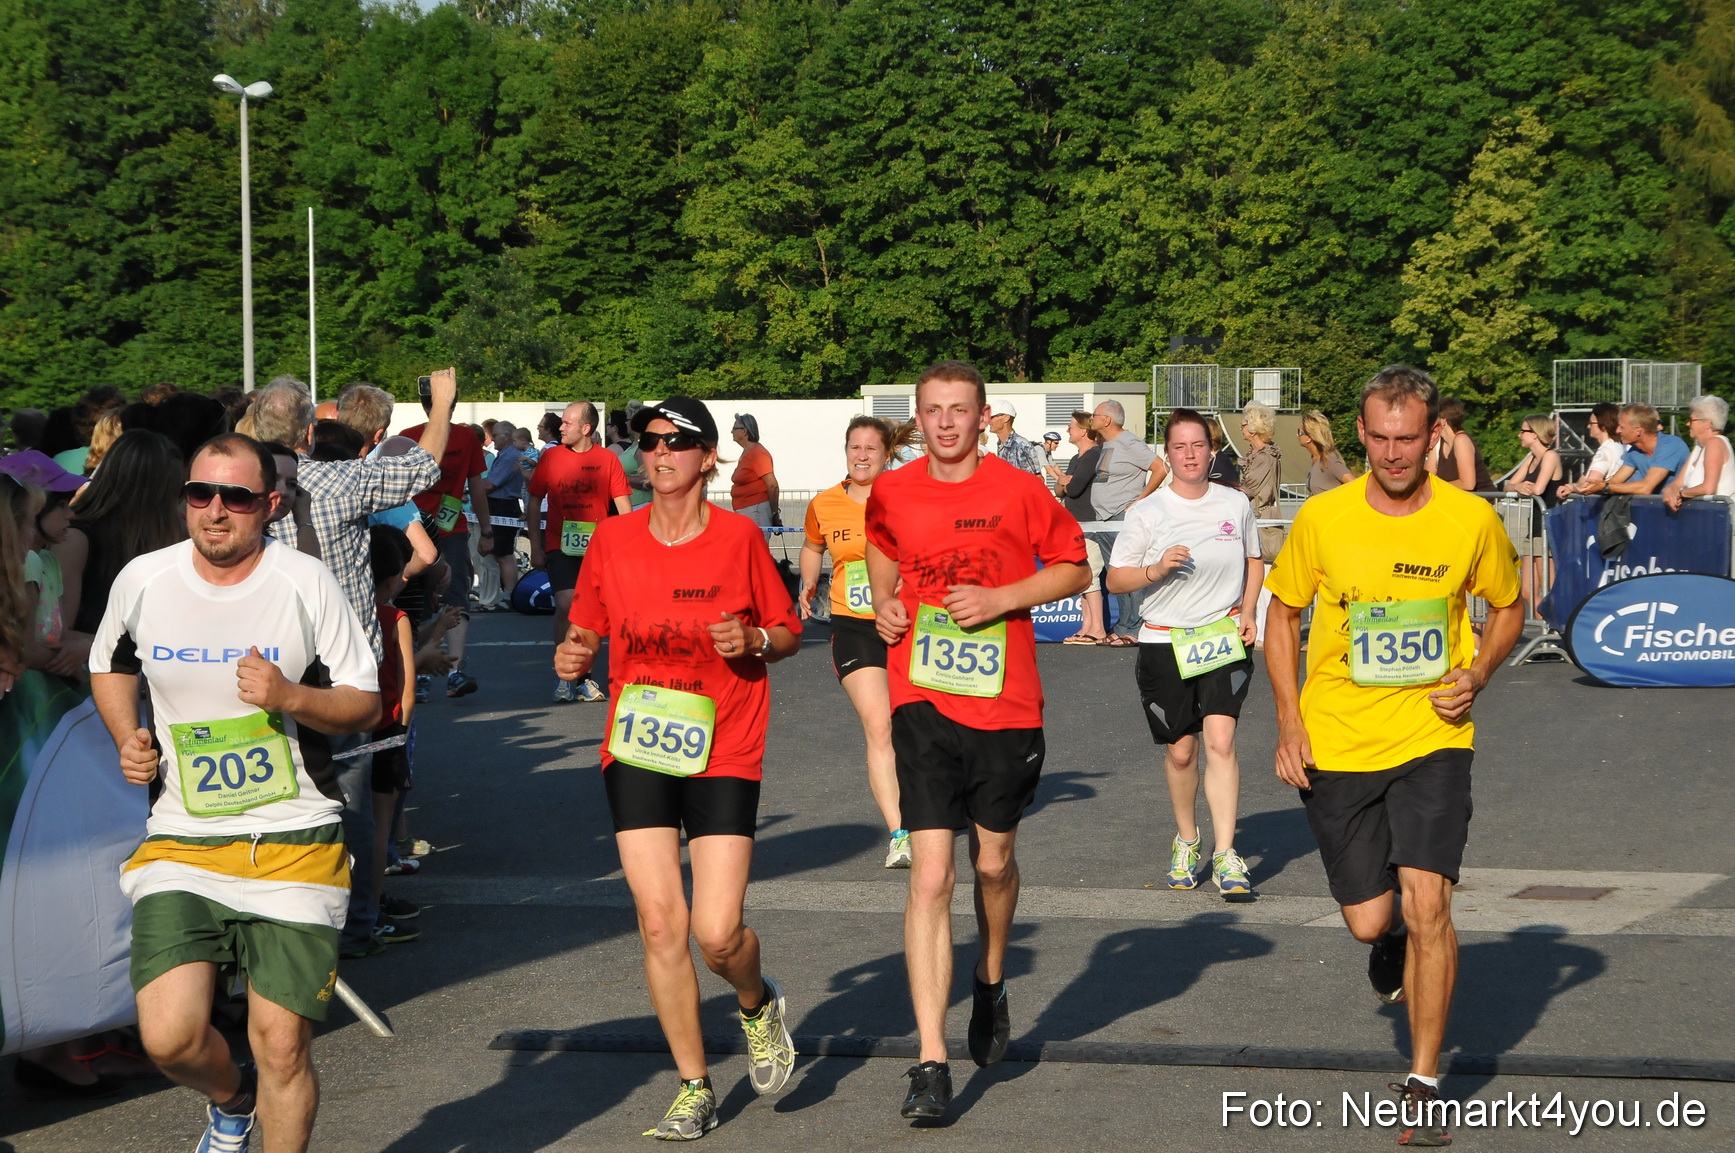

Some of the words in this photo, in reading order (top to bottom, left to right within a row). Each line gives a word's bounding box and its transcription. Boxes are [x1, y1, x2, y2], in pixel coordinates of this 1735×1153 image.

[437, 507, 458, 523] 57
[954, 519, 986, 529] swn
[563, 532, 590, 548] 135
[832, 528, 851, 543] PE
[1393, 562, 1432, 577] swn
[672, 588, 706, 599] swn
[849, 585, 873, 607] 50
[1624, 622, 1735, 649] Fische
[1186, 636, 1233, 665] 424
[1353, 628, 1443, 665] 1350
[916, 634, 1000, 676] 1353
[1636, 650, 1735, 662] AUTOMOBIL
[633, 675, 665, 688] Alles
[669, 677, 704, 691] läuft
[936, 671, 952, 679] Enrico
[952, 673, 975, 681] Gebhard
[618, 712, 706, 759] 1359
[634, 747, 650, 756] Ulrike
[191, 746, 274, 793] 203
[205, 801, 223, 809] Delphi
[223, 796, 258, 806] Deutschland
[258, 791, 277, 800] GmbH
[217, 791, 237, 799] Daniel
